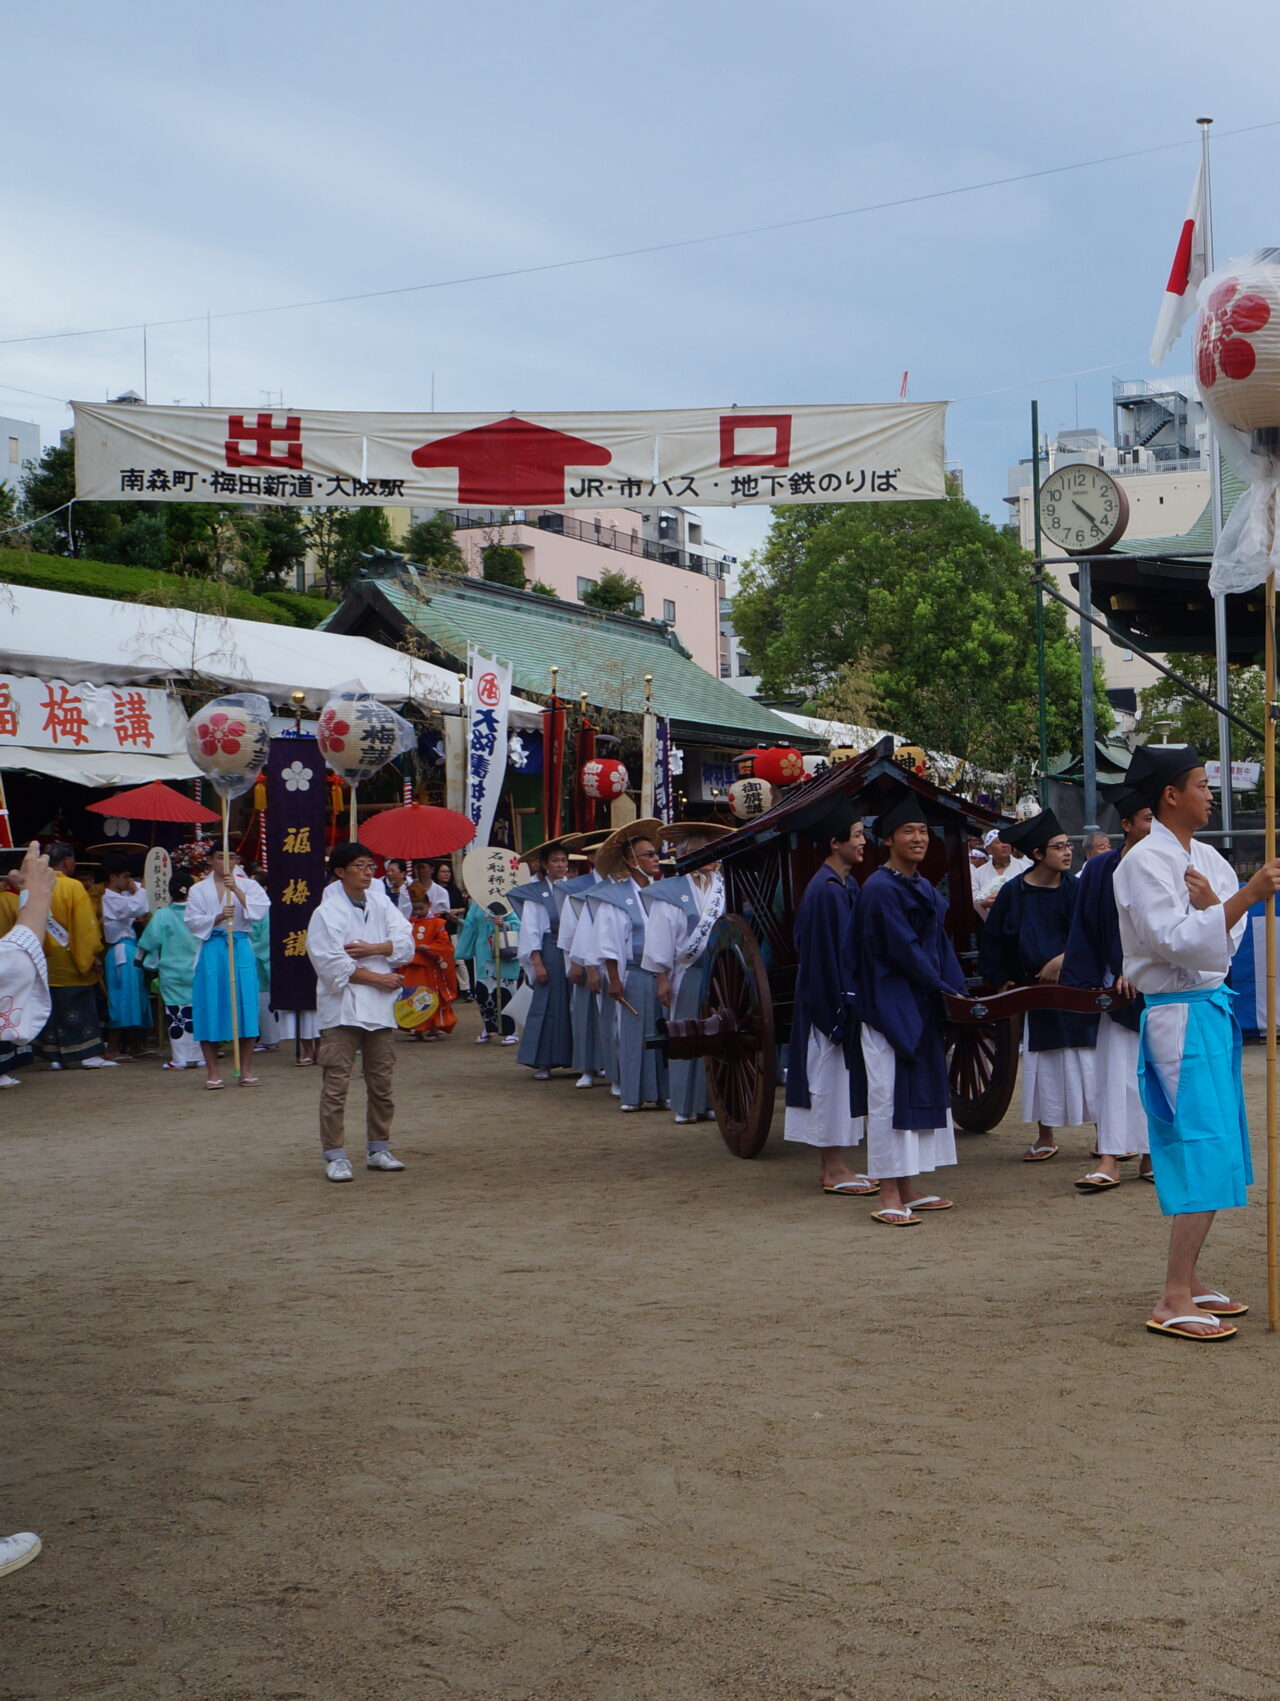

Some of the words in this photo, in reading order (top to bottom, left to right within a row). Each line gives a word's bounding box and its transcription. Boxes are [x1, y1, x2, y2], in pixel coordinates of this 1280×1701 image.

[225, 413, 303, 469] 出
[719, 415, 793, 468] 口
[1060, 477, 1071, 491] 11
[1073, 474, 1087, 487] 12
[1091, 476, 1097, 489] 1
[1049, 489, 1062, 502] 10
[1100, 485, 1109, 498] 2
[1046, 504, 1056, 517] 9
[1103, 500, 1114, 513] 3
[1051, 517, 1061, 530] 8
[1099, 515, 1110, 527] 4
[1064, 528, 1073, 540] 7
[1075, 530, 1085, 543] 6
[1090, 525, 1100, 538] 5
[741, 781, 763, 815] 御旗講
